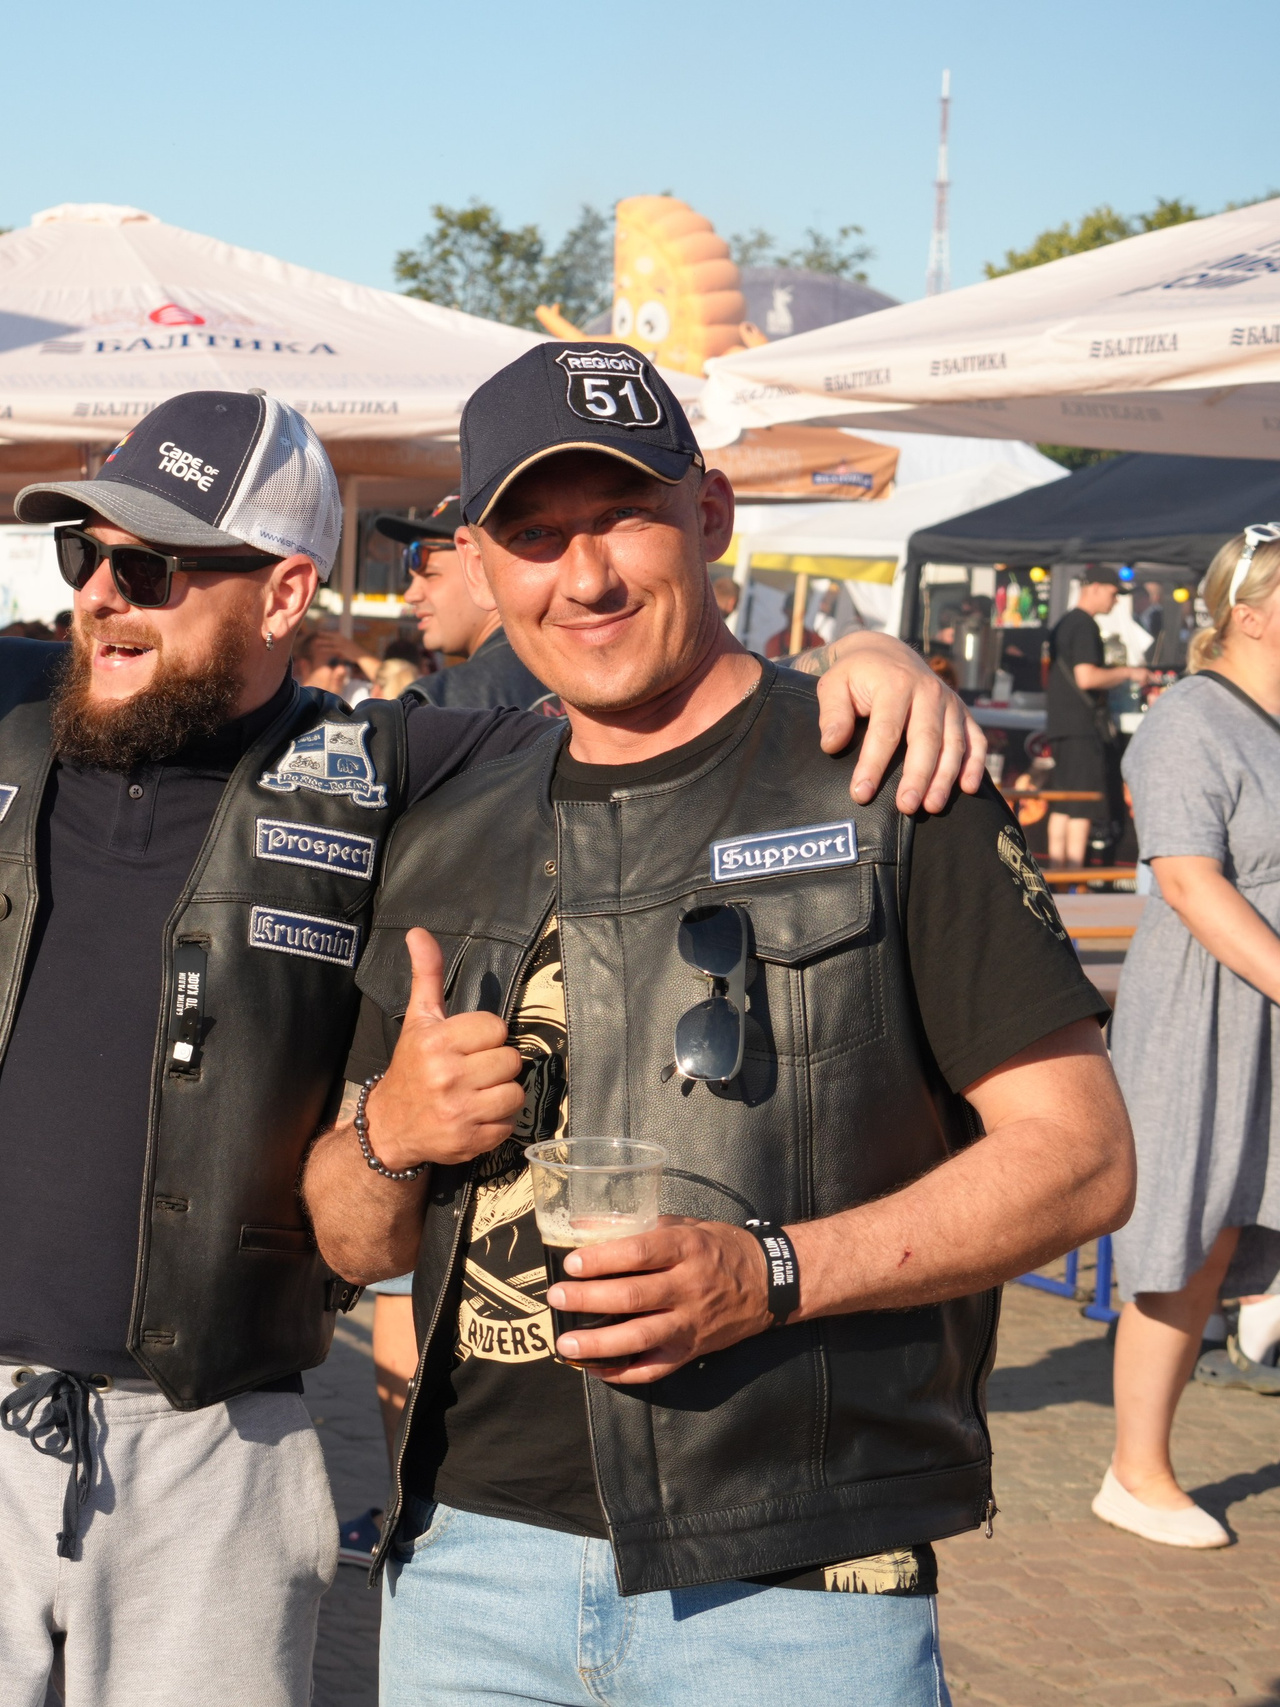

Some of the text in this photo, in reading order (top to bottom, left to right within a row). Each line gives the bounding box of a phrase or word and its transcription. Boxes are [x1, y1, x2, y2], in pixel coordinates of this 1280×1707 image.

[94, 334, 337, 354] БАЛТИКА
[1103, 333, 1178, 358] БАЛТИКА
[567, 357, 636, 371] REGION
[942, 353, 1007, 376] БАЛТИКА
[92, 402, 157, 416] БАЛТИ
[310, 401, 399, 414] БАЛТИКА
[583, 378, 643, 420] 51
[260, 828, 371, 864] Prospect
[721, 834, 848, 869] Support
[254, 915, 350, 957] Krutenin
[187, 971, 200, 996] КАФЕ
[763, 1237, 785, 1287] МОТО КАФЕ
[468, 1317, 548, 1356] RIDERS
